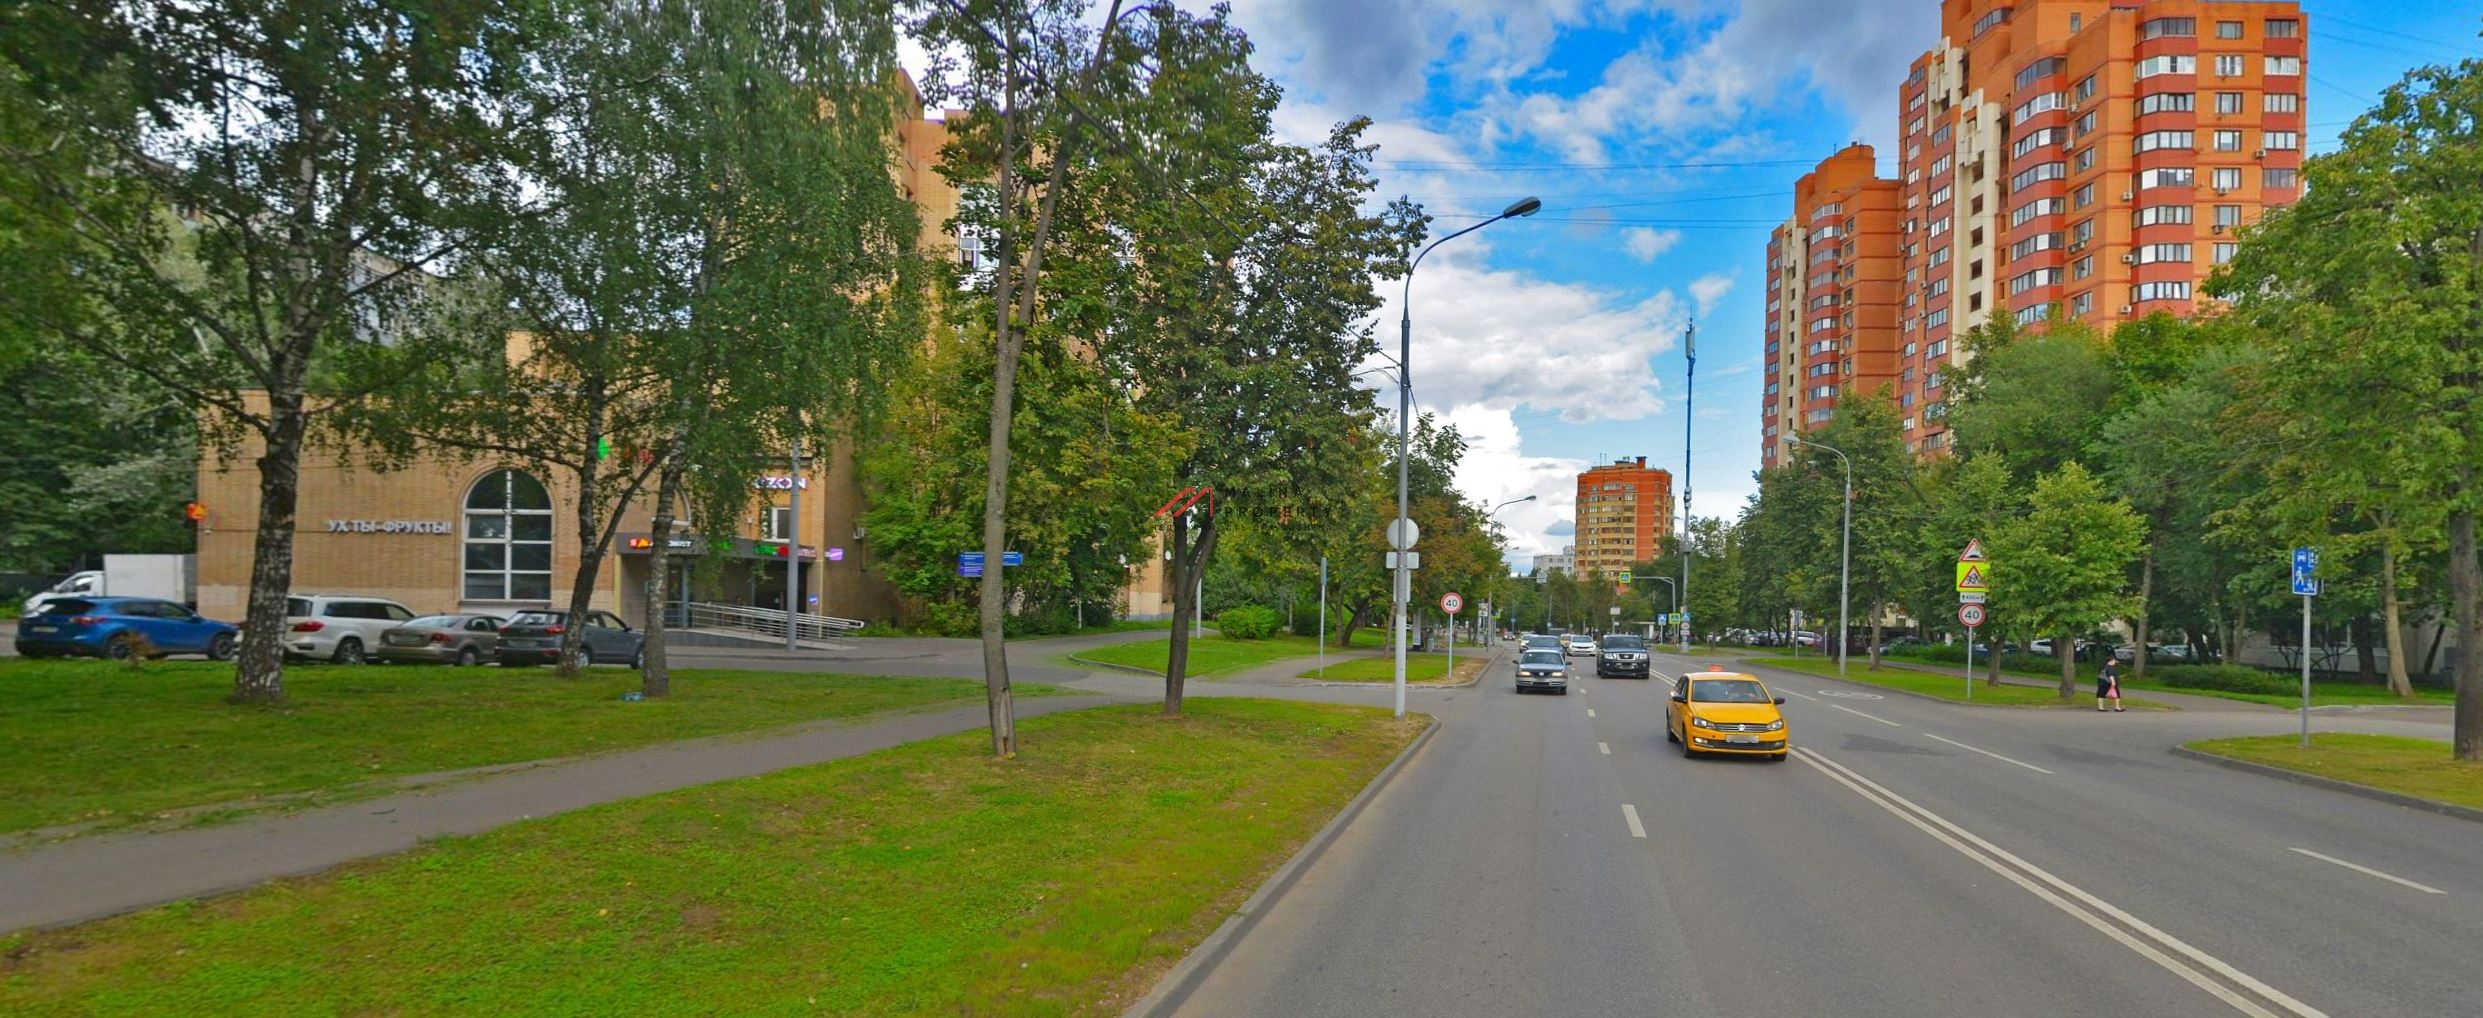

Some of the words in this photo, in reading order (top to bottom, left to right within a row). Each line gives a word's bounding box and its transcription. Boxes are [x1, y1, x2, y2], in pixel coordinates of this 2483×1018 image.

[754, 477, 807, 489] OZON
[1446, 599, 1458, 607] 40
[1965, 610, 1979, 619] 40
